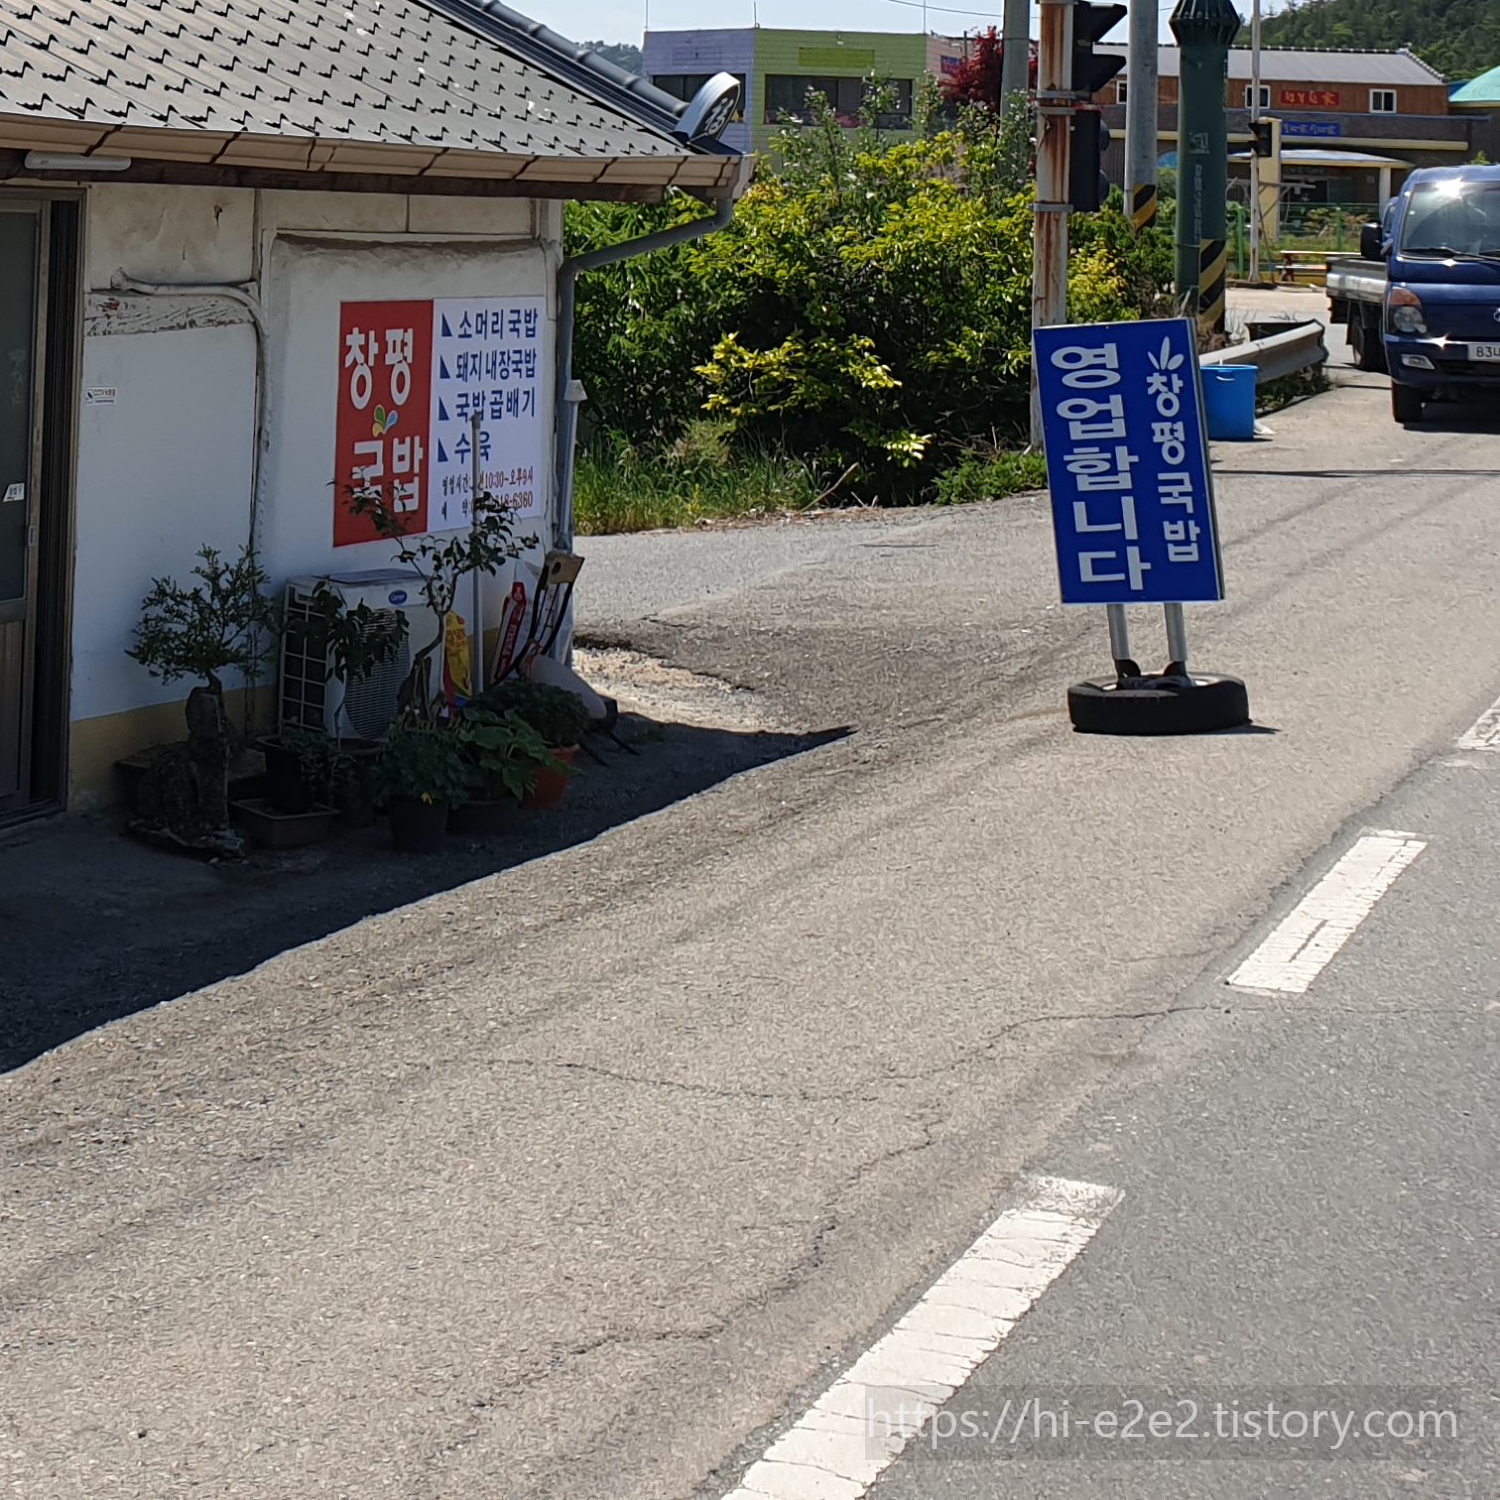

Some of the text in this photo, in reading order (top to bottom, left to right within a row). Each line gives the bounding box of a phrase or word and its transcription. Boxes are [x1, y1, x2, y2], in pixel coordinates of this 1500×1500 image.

[345, 327, 414, 410] 창평
[352, 435, 424, 515] 국밥
[1050, 342, 1152, 591] 영업합니다
[1146, 372, 1201, 562] 창평국밥
